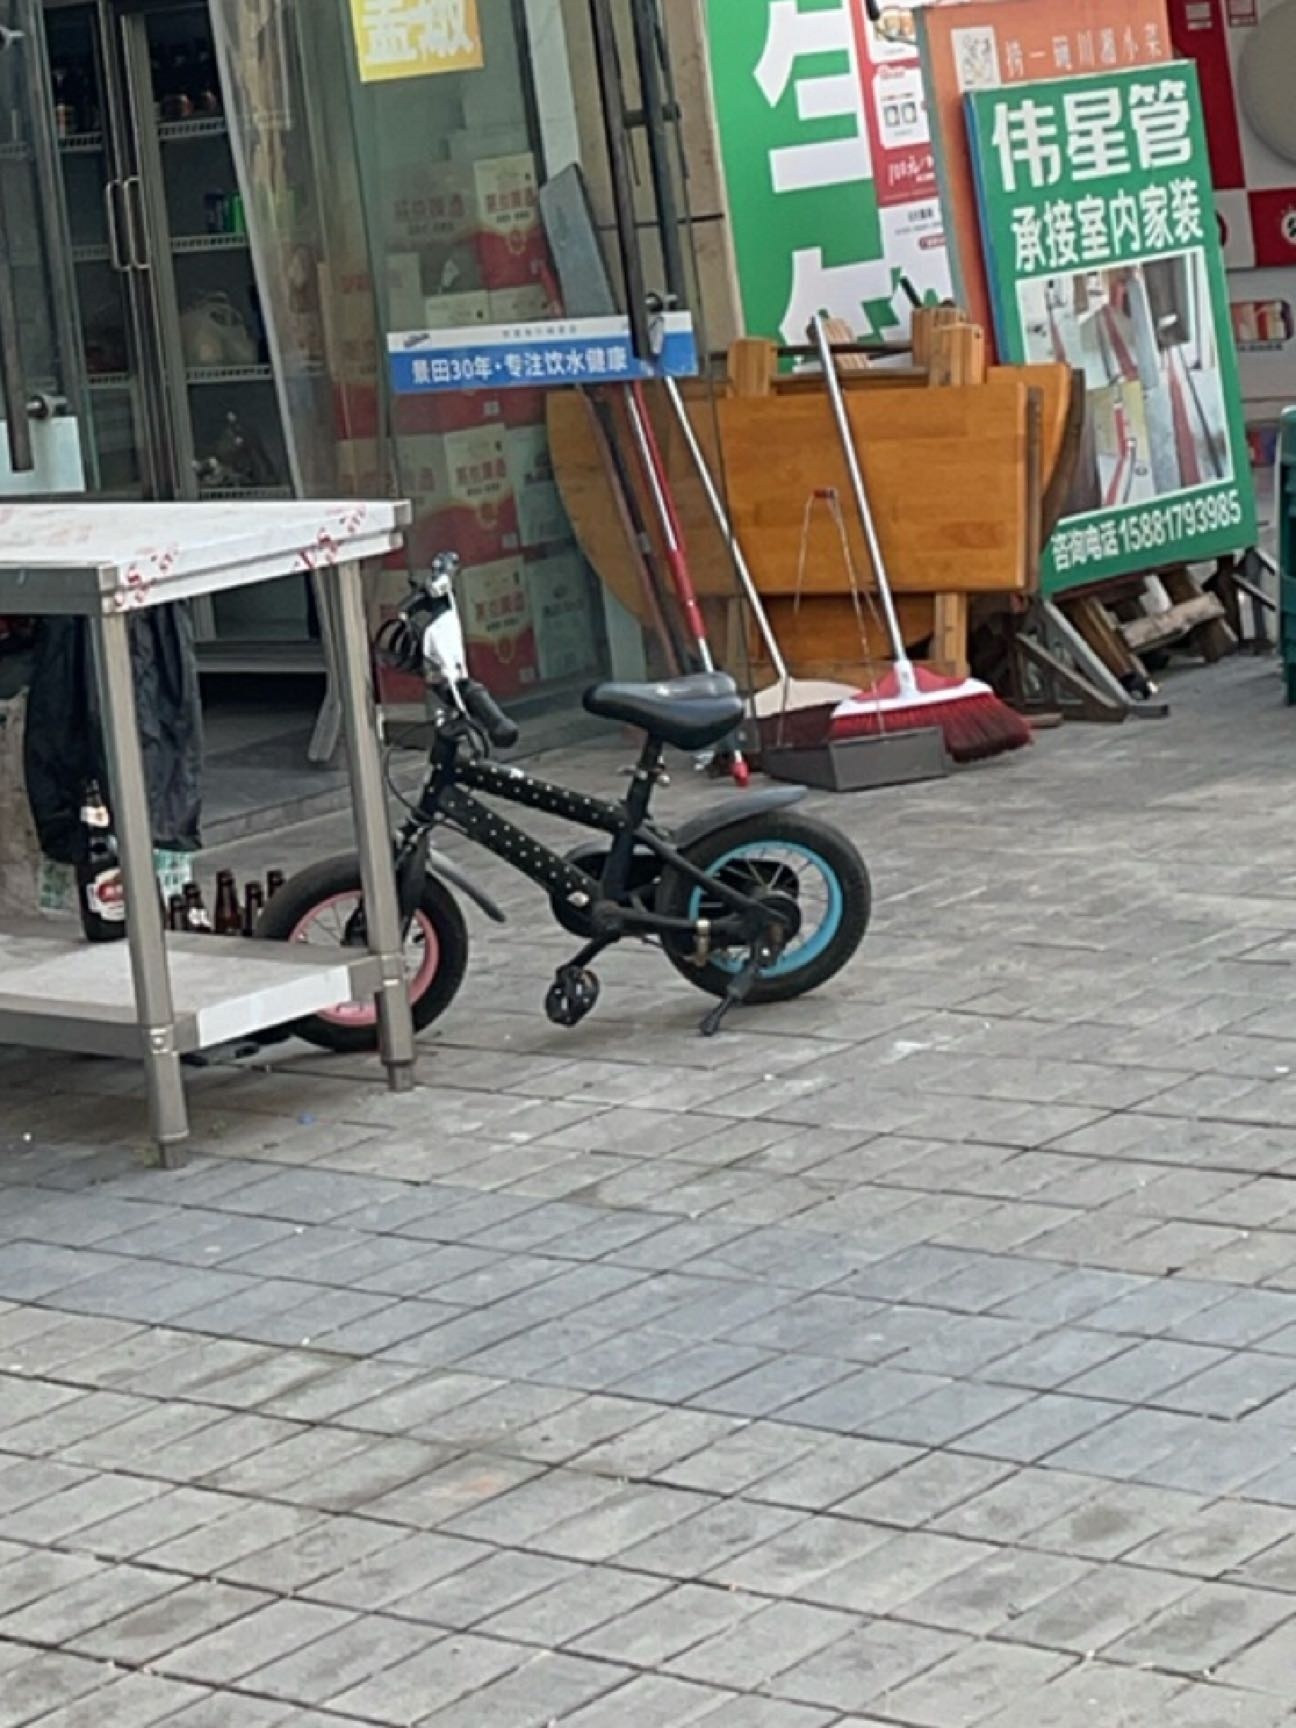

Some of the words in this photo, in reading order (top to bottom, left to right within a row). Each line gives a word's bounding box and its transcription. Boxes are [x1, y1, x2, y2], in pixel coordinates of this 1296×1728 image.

[991, 78, 1193, 193] 伟星管
[1010, 176, 1204, 272] 承接室内家装
